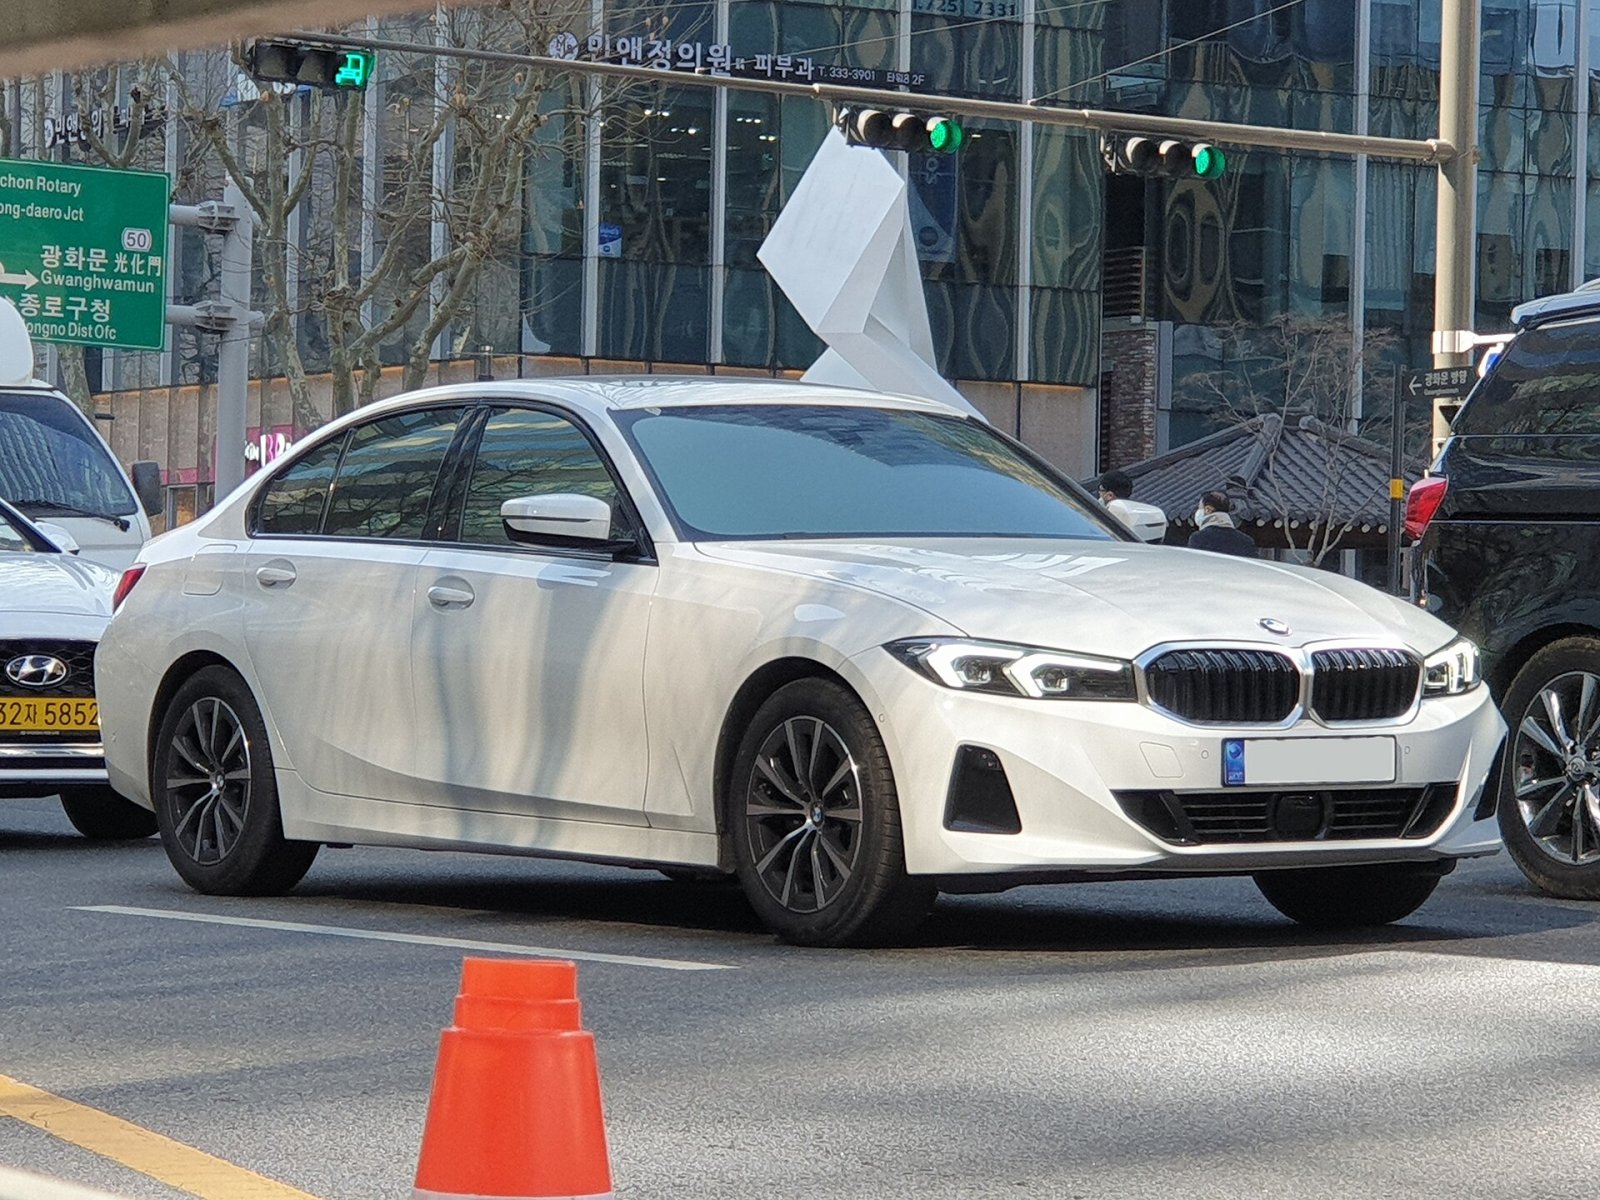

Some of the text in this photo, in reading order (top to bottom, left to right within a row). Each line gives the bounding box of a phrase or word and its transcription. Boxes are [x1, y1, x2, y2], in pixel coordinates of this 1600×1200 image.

[974, 2, 1016, 16] 7331
[588, 34, 731, 77] 민앤정의원
[754, 54, 815, 81] 피부과
[818, 67, 828, 77] T.
[829, 66, 876, 81] 333-3901
[912, 74, 925, 85] 2F
[36, 176, 82, 198] Rotary
[63, 205, 84, 221] Jct
[126, 231, 147, 248] 50
[40, 245, 162, 277] 광화문 光化門
[40, 269, 155, 293] Gwanghwamun
[18, 292, 110, 323] 종로구청
[25, 321, 117, 340] ongno Dist Ofc
[44, 702, 99, 726] 5852
